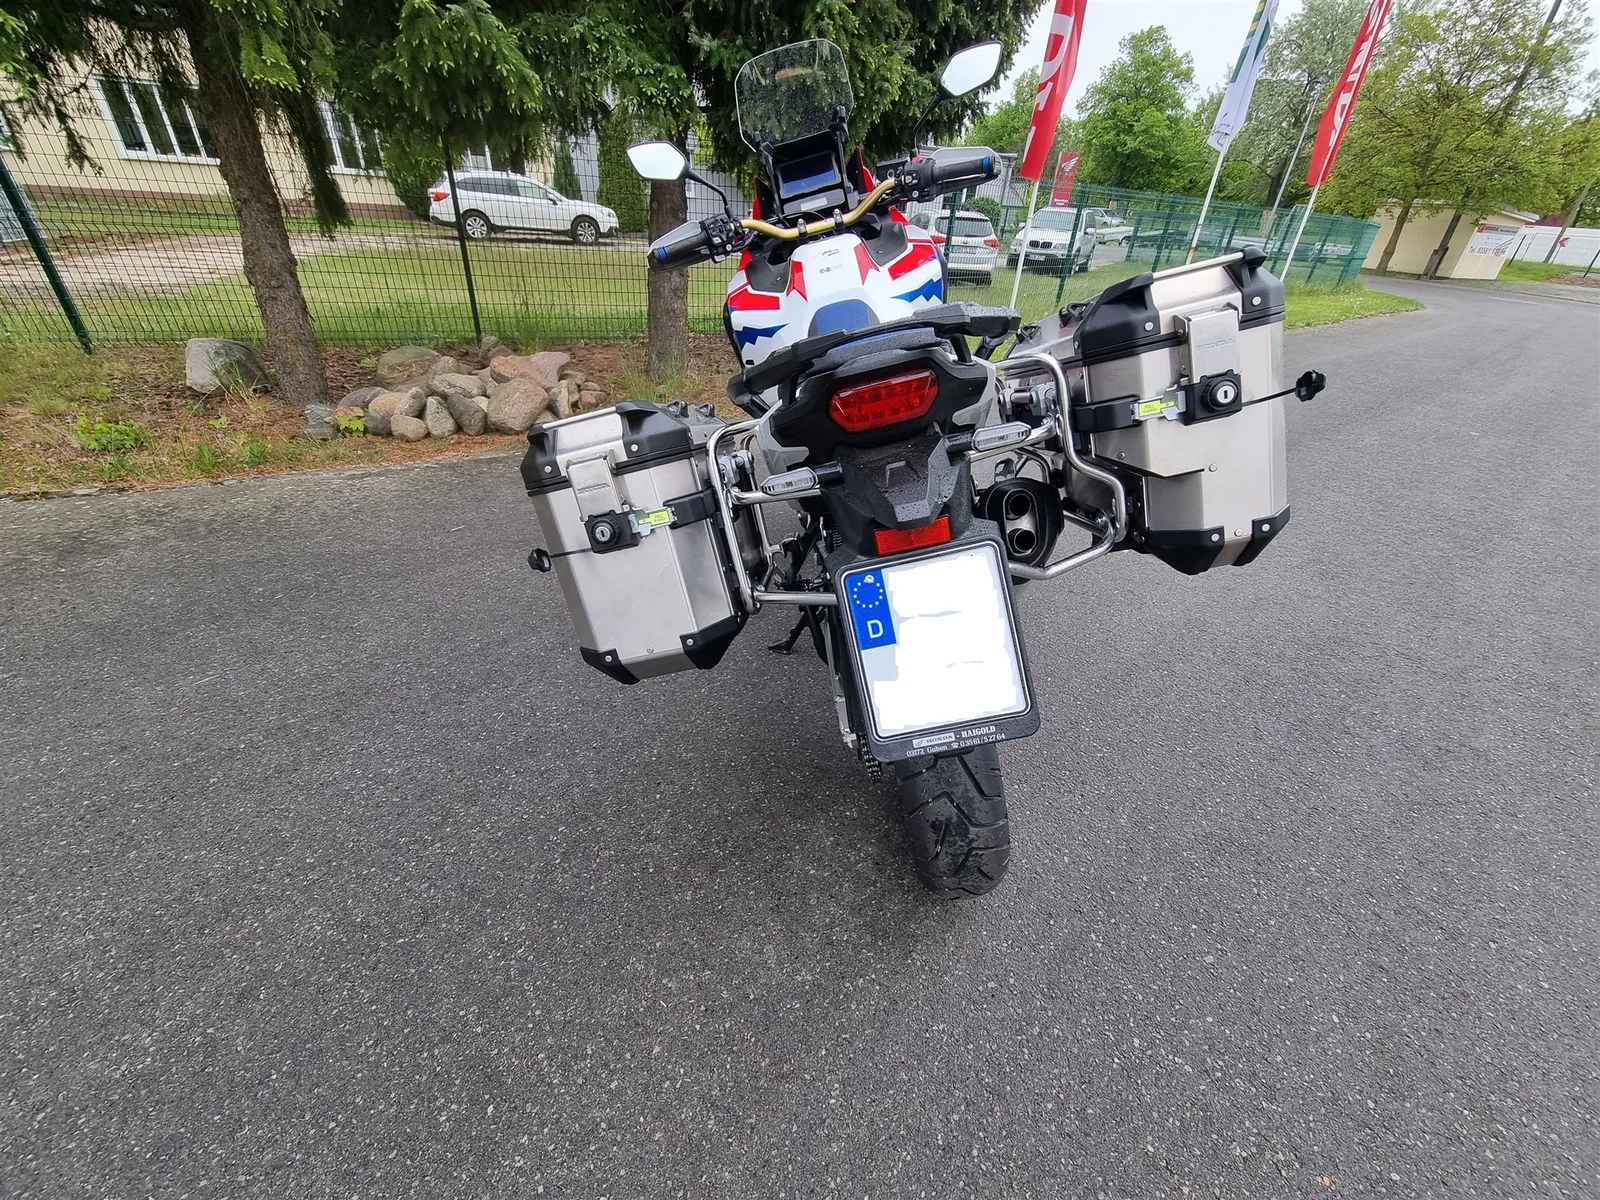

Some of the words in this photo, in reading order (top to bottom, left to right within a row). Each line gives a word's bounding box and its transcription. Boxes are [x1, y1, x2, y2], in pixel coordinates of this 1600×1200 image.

[1196, 337, 1235, 351] HONDA
[867, 619, 884, 638] D
[926, 735, 953, 743] HONDA
[961, 725, 996, 738] HAIGOLD
[927, 744, 948, 753] Guben
